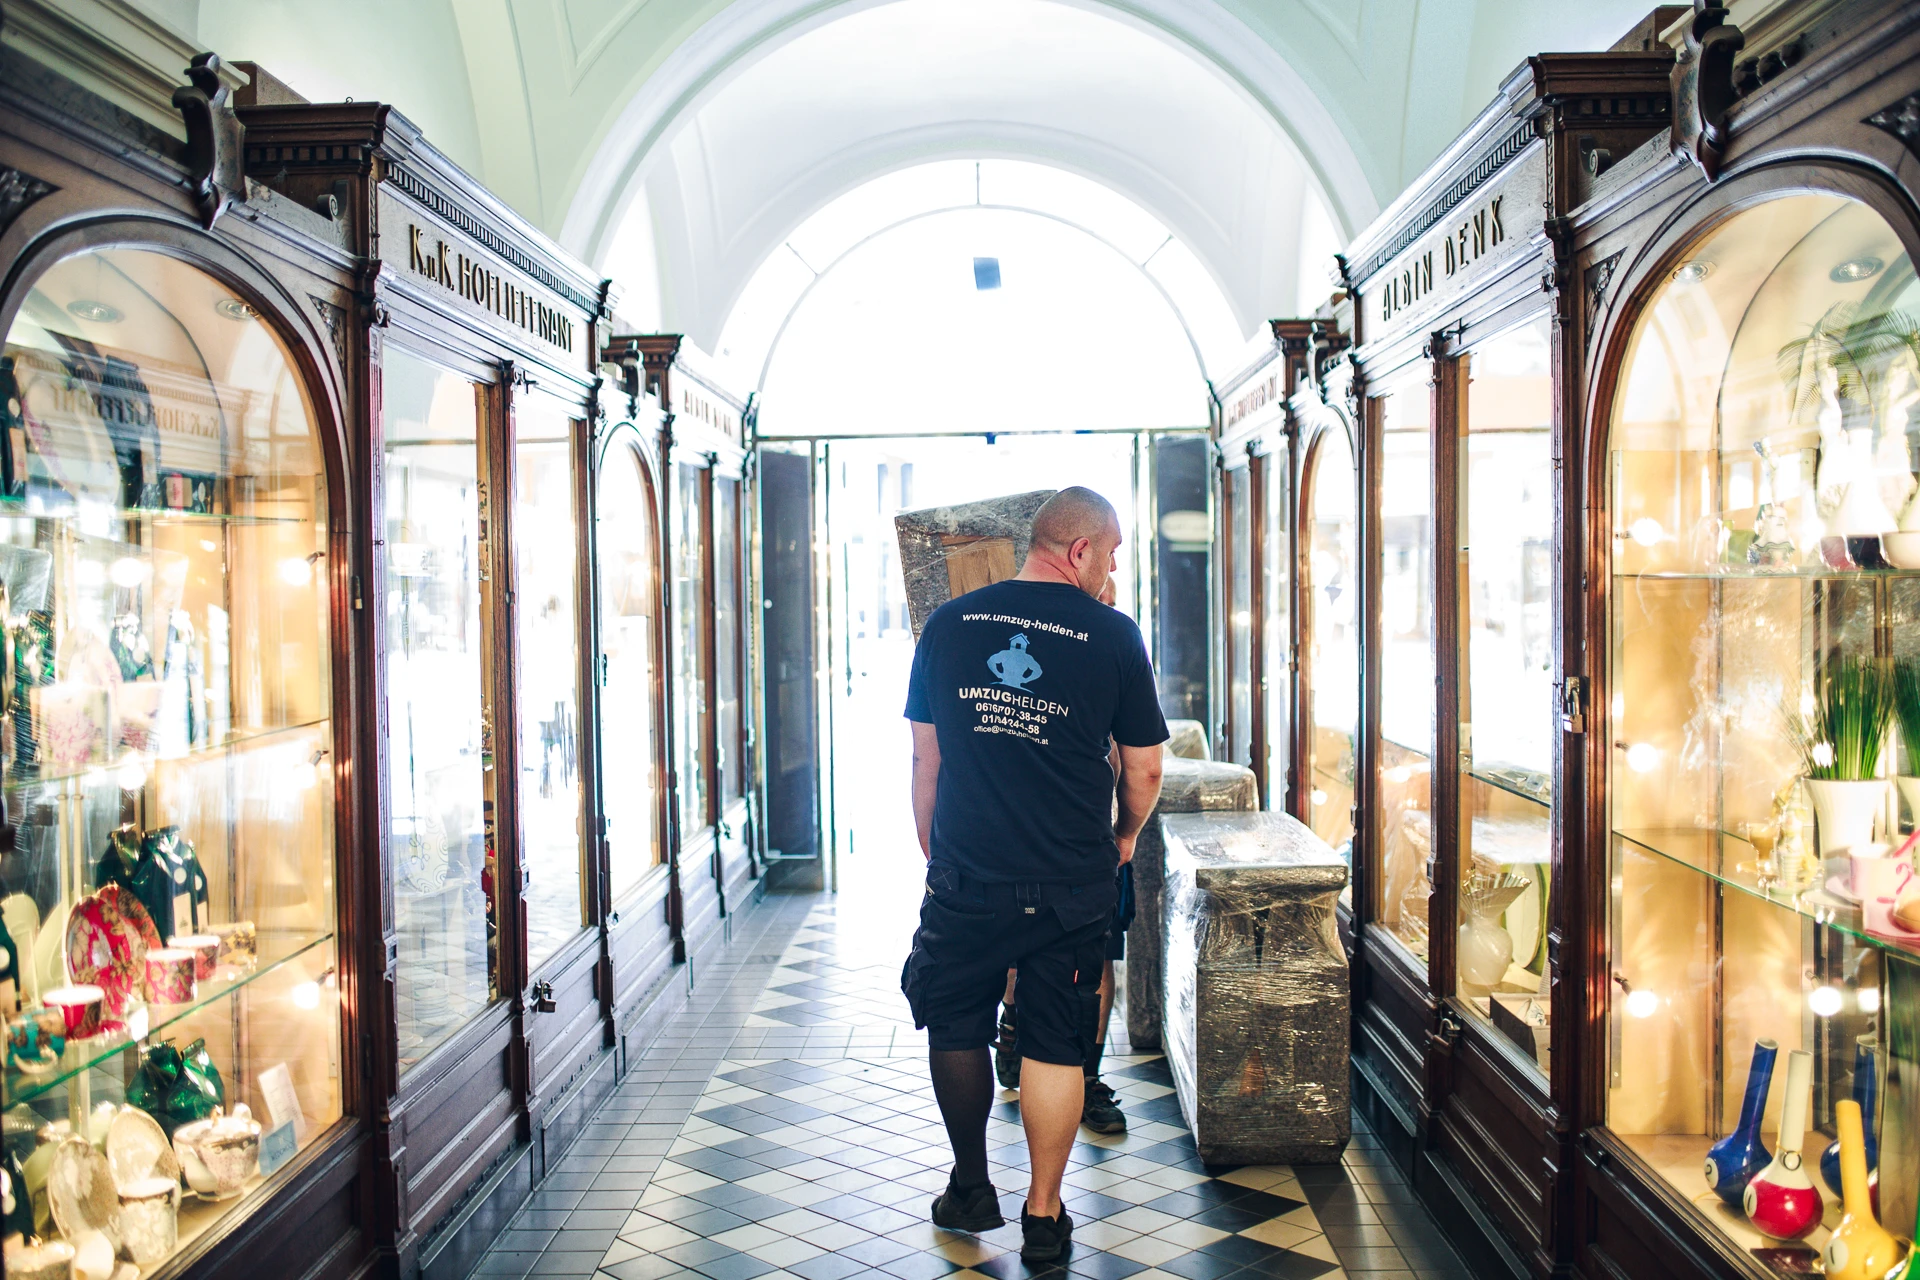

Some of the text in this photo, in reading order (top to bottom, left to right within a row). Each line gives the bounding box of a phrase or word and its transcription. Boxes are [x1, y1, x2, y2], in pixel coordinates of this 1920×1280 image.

[1383, 194, 1504, 322] ALBIN DENK
[962, 613, 1089, 642] www.umzug-helden.at
[958, 687, 1069, 717] UMZUGHELDEN
